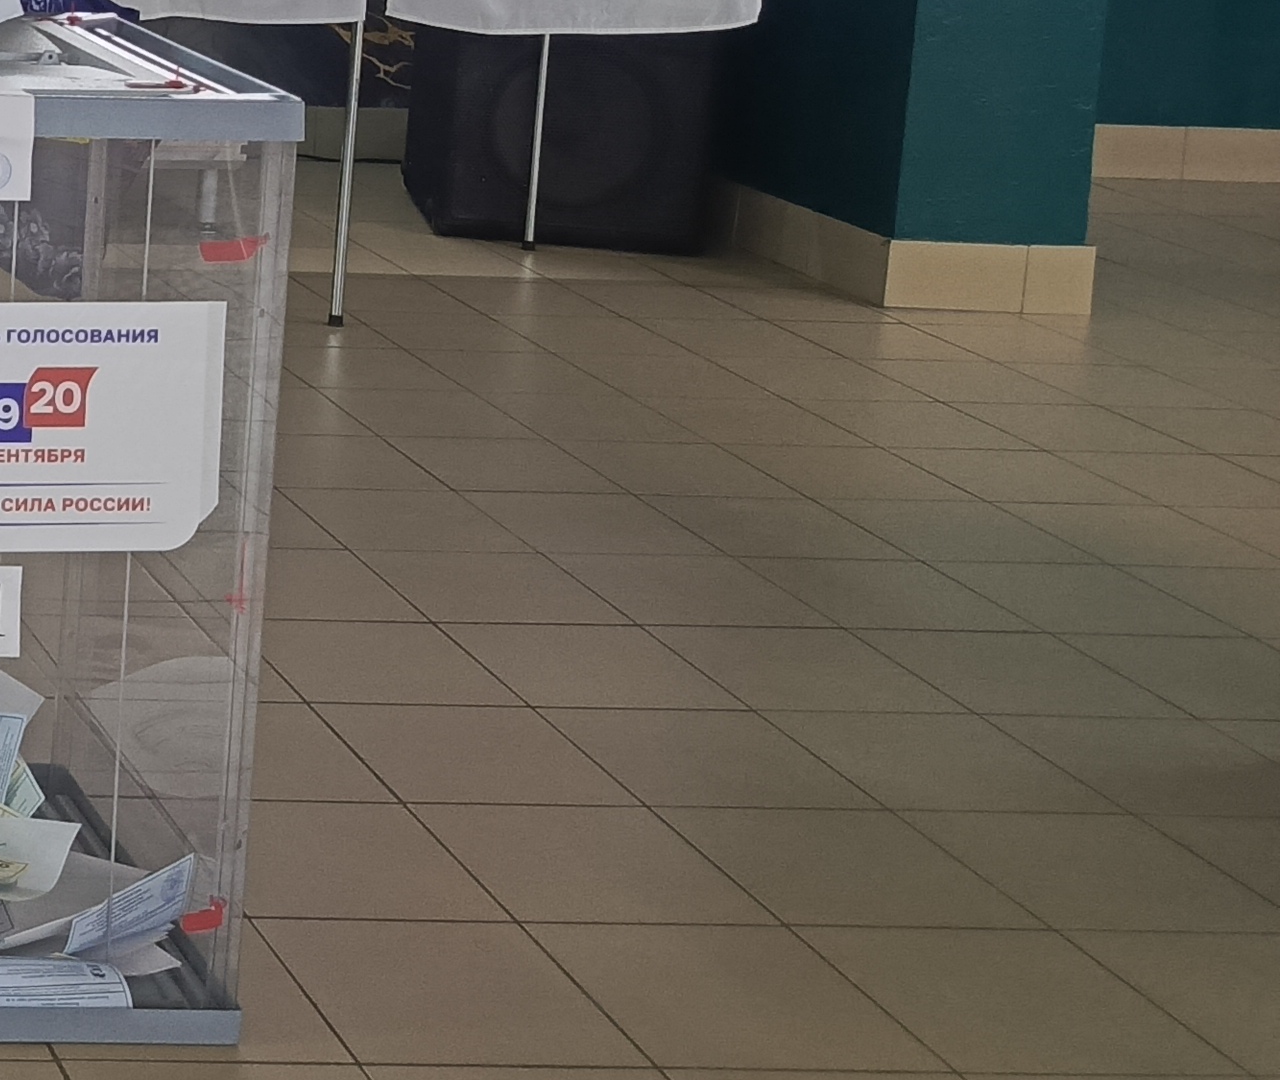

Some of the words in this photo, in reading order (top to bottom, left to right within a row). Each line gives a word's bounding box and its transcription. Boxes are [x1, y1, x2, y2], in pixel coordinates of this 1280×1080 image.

[6, 328, 159, 344] ГОЛОСОВАНИЯ
[29, 379, 82, 414] 20
[0, 497, 56, 513] СИЛА
[61, 496, 151, 513] РОССИИ!
